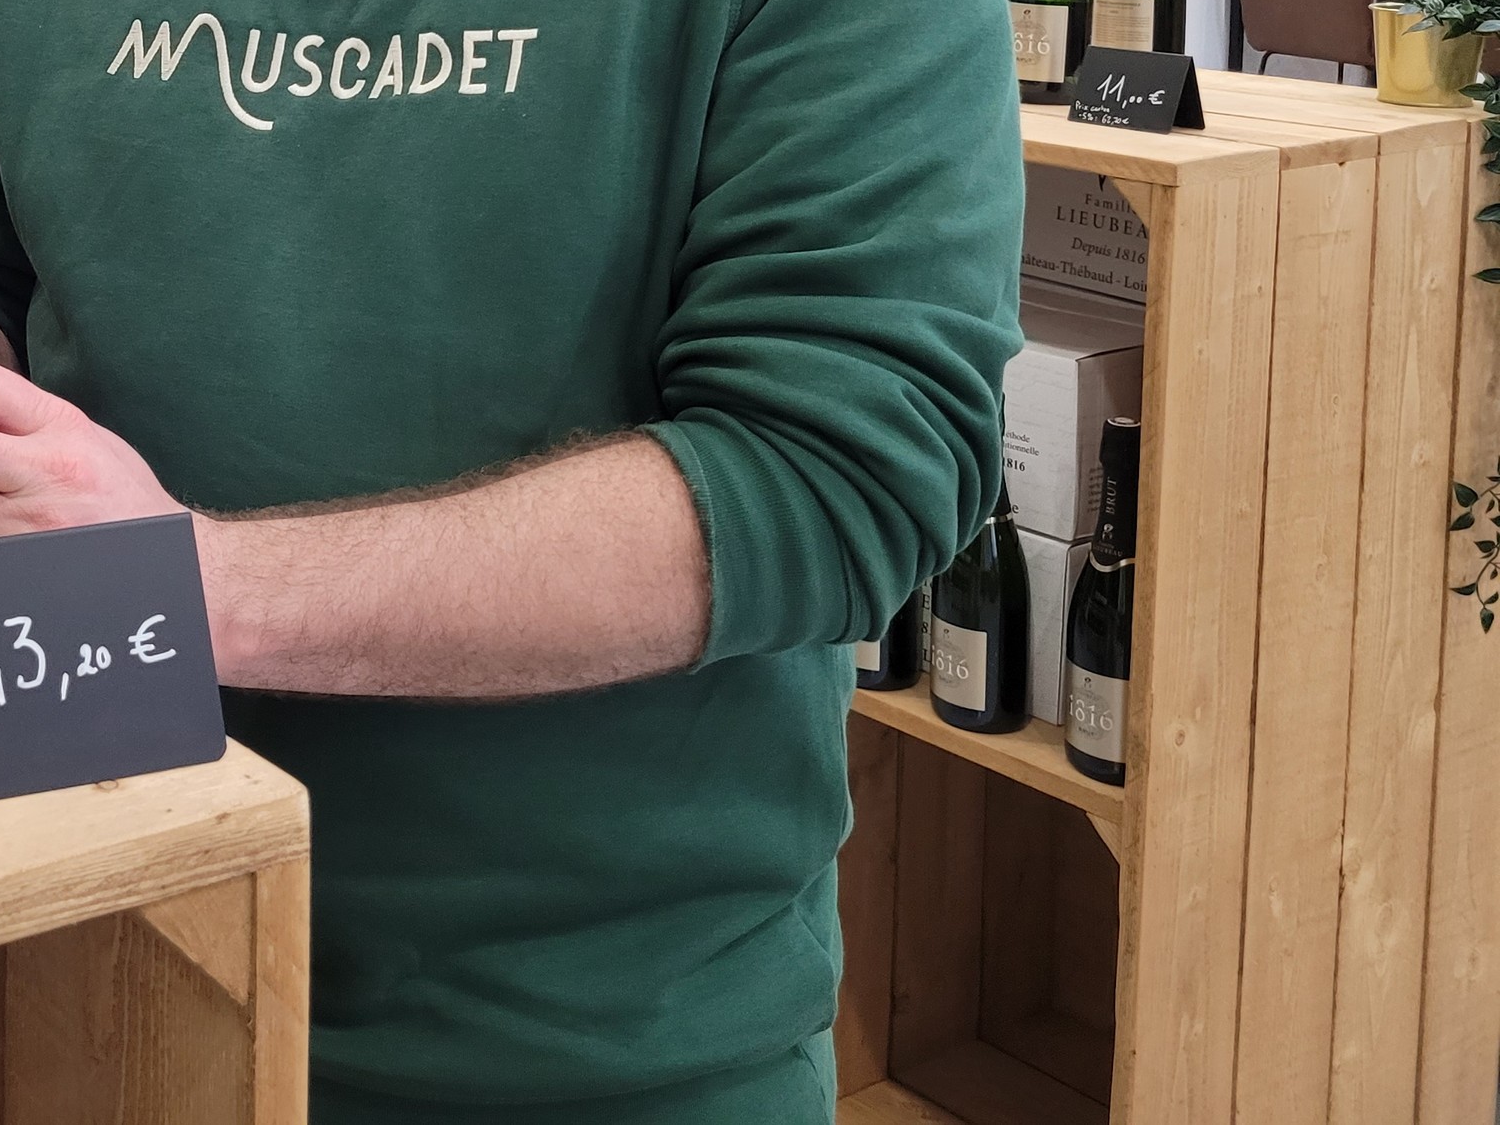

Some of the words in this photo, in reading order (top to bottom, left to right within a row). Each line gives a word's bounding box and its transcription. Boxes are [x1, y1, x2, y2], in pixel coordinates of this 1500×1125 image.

[106, 12, 539, 131] MUSCADET
[1075, 100, 1088, 111] Prix
[1097, 73, 1143, 109] 11,00
[1148, 90, 1165, 105] €
[1056, 205, 1148, 239] LIEUBEA
[1071, 236, 1112, 257] Depuis
[1114, 247, 1146, 264] 1816
[1005, 430, 1031, 443] ethode
[1005, 442, 1040, 457] tionnelle
[1005, 457, 1026, 472] 816
[1104, 477, 1117, 516] BRUT
[127, 614, 177, 664] €
[1068, 694, 1114, 731] 1816
